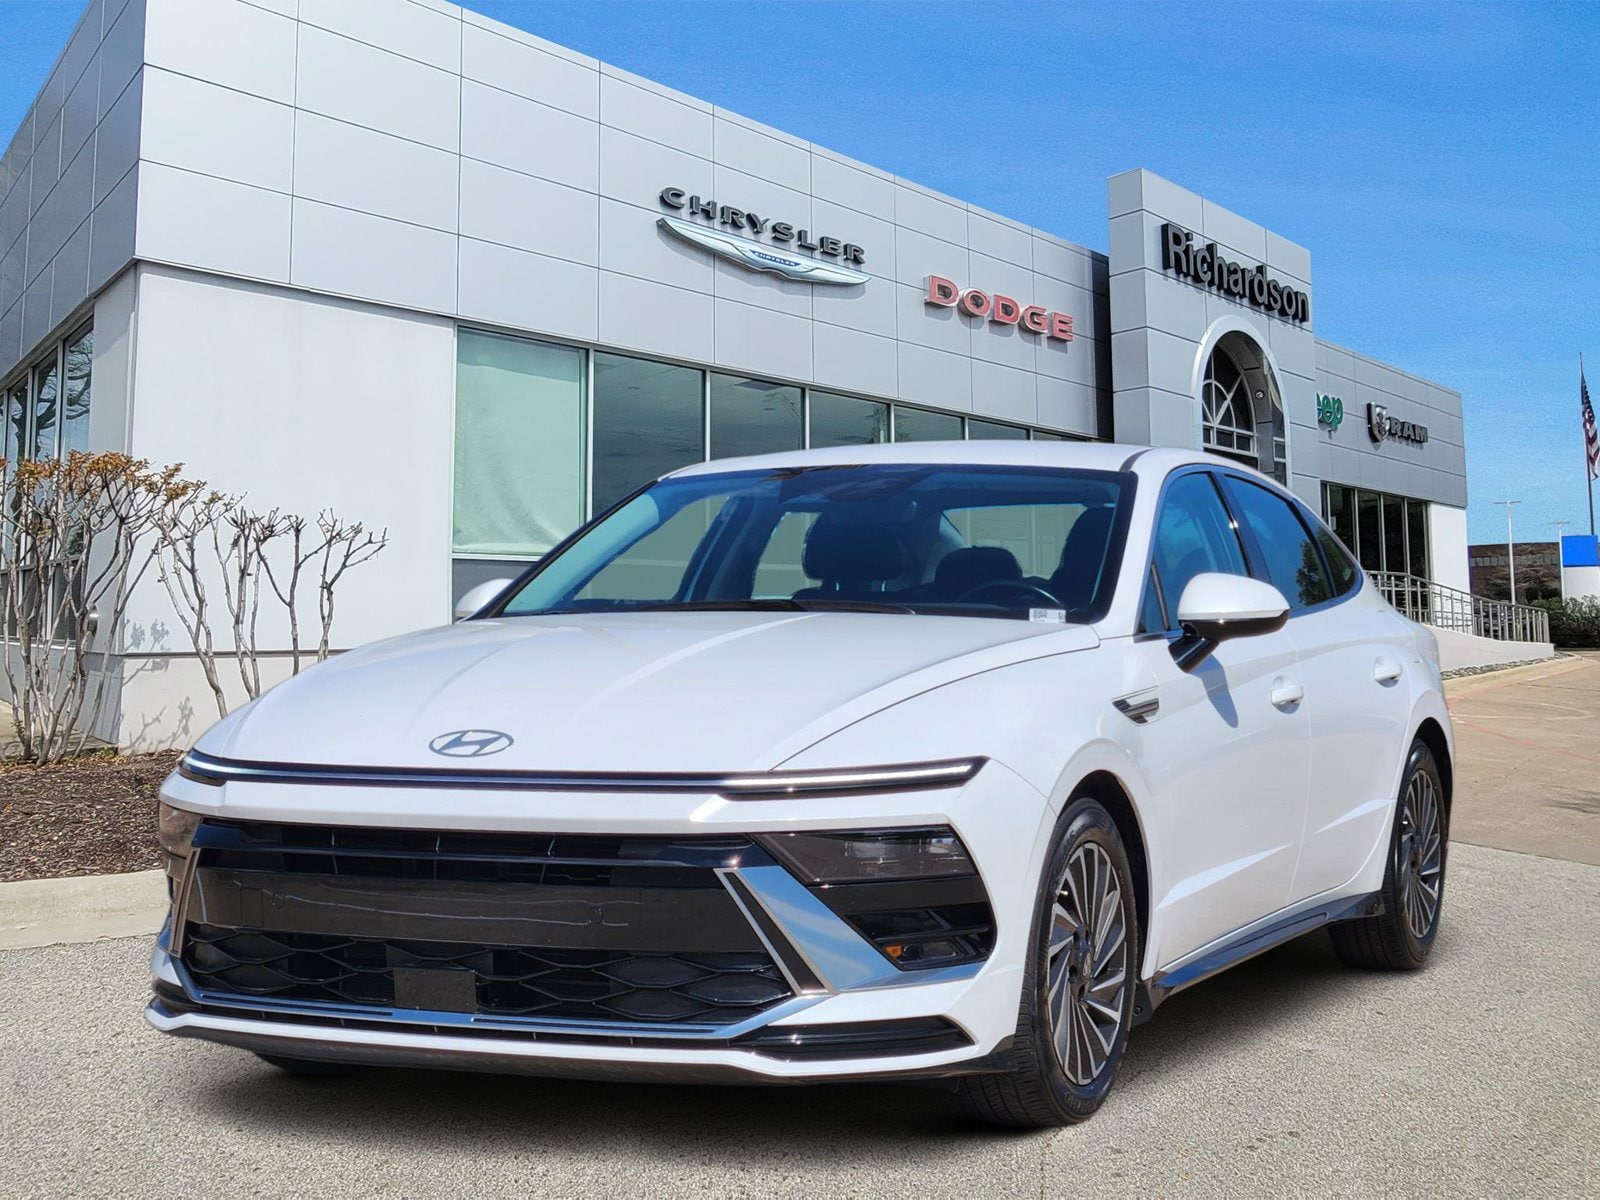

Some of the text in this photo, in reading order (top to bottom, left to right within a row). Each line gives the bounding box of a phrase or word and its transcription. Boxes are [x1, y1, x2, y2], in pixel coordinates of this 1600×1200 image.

[659, 187, 866, 264] CHRYSLER
[923, 275, 1073, 342] DODGE
[1161, 223, 1309, 323] Richardson
[1388, 416, 1429, 443] RAM
